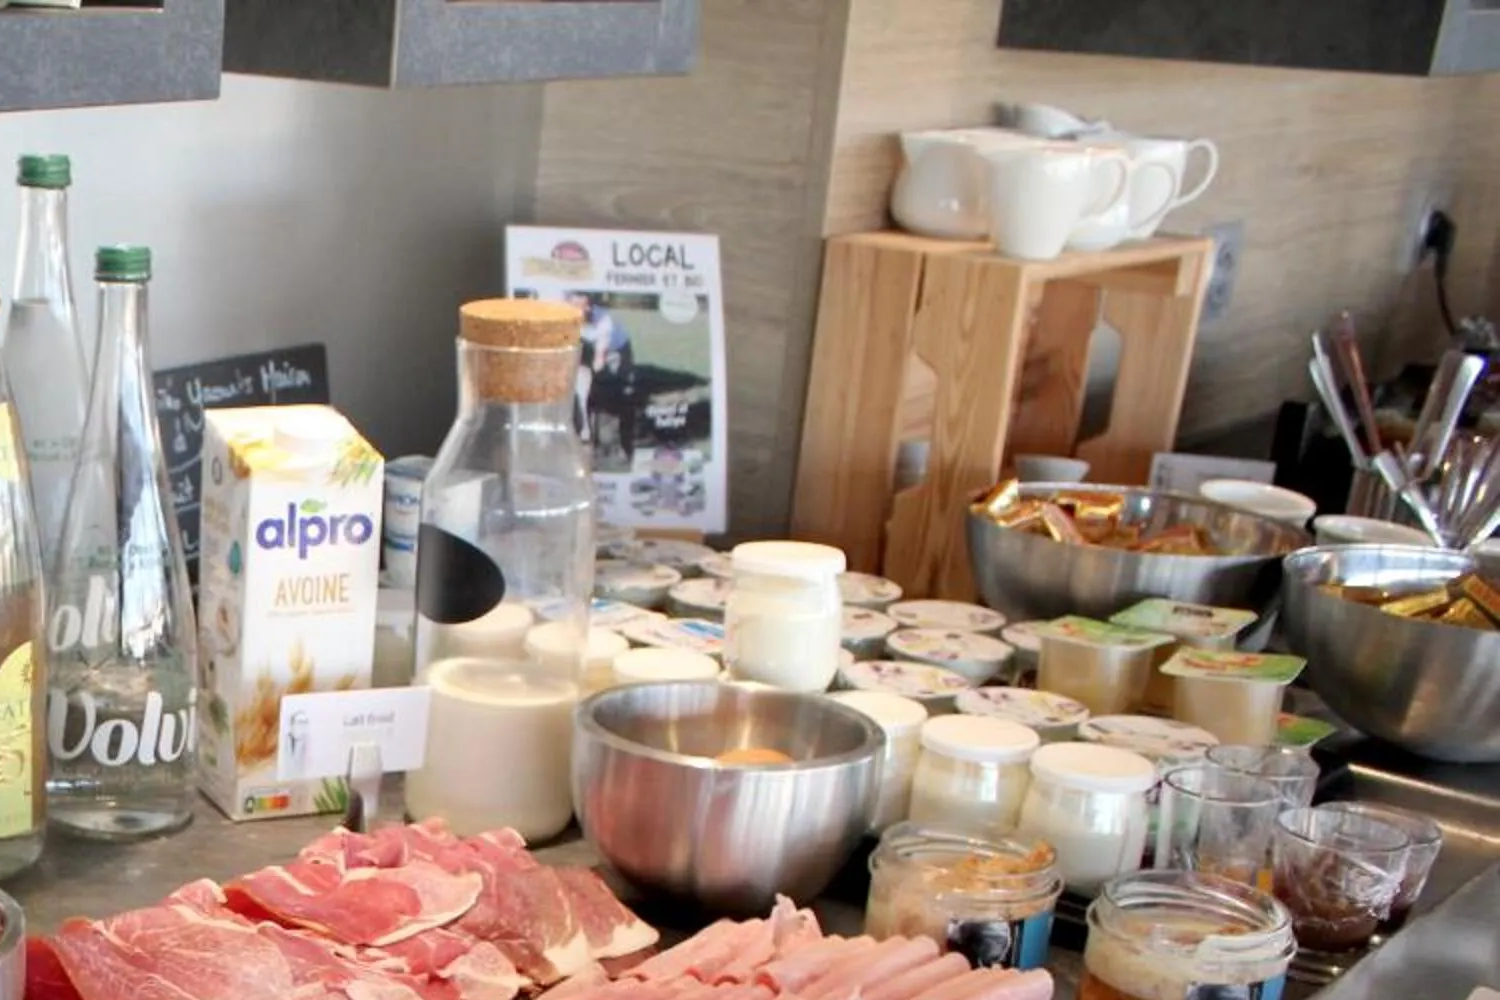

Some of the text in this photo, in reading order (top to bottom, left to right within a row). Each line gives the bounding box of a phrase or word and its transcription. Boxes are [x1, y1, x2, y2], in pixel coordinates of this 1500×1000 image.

[611, 241, 695, 270] LOCAL
[255, 502, 373, 560] alpro
[275, 573, 351, 607] AVOINE
